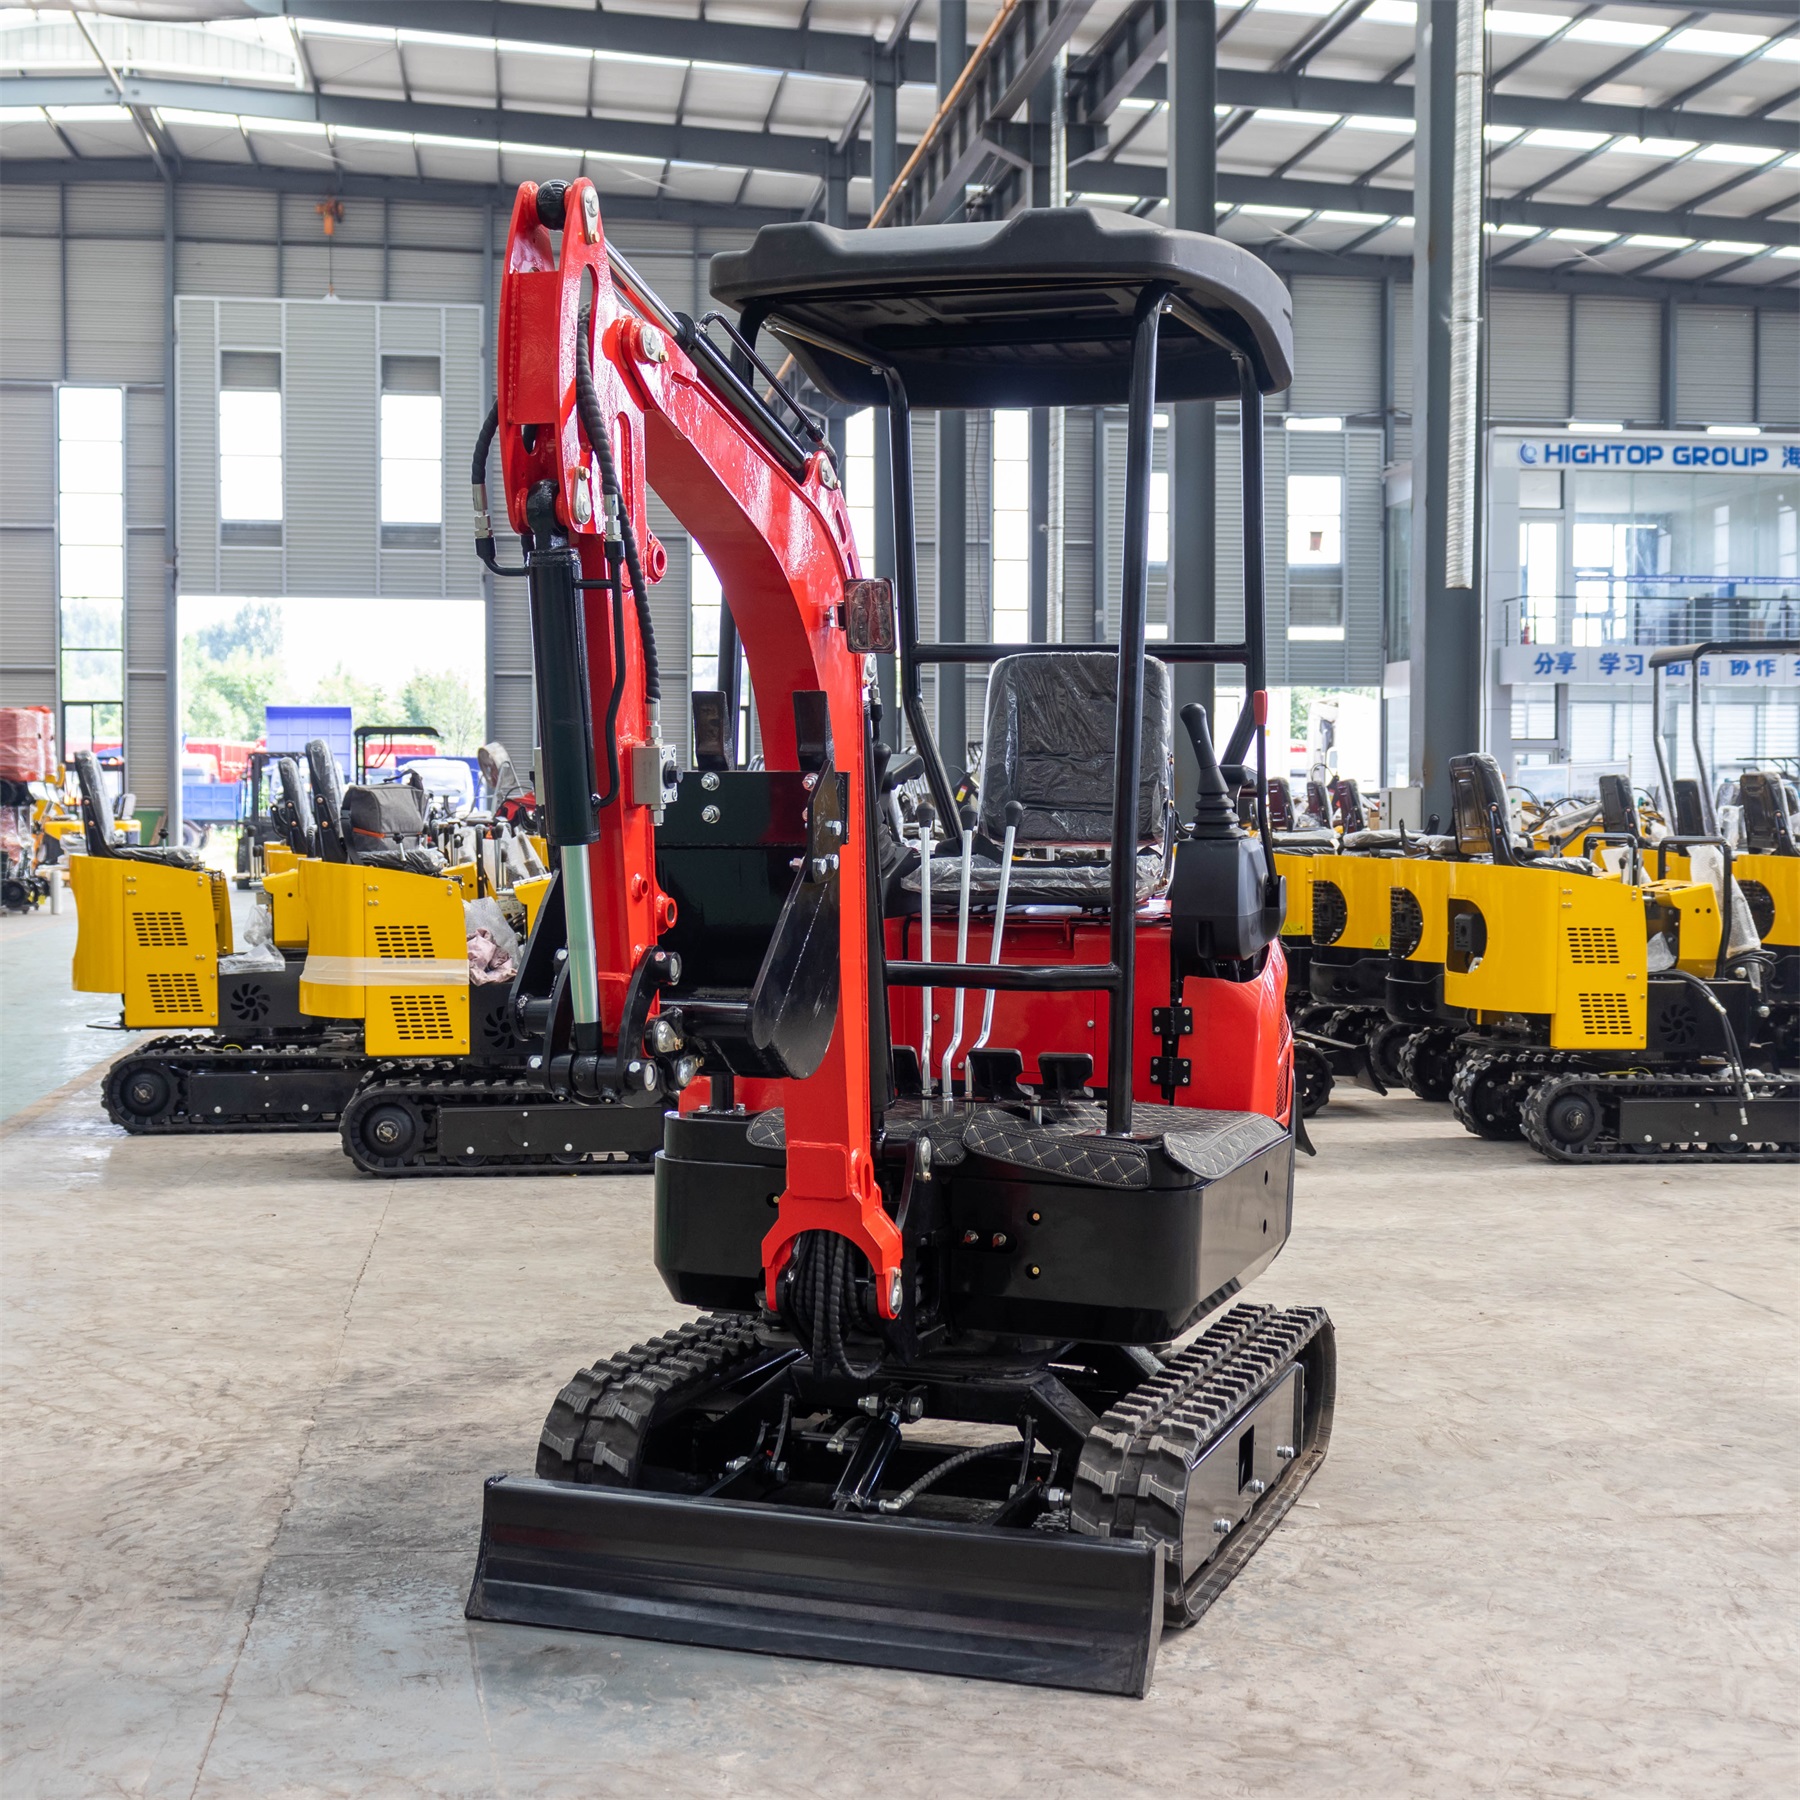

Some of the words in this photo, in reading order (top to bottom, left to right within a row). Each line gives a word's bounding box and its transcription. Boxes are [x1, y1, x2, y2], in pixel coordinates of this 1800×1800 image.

[1544, 444, 1664, 465] HIGHTOP
[1672, 445, 1769, 467] GROUP
[1534, 652, 1576, 675] 分享
[1600, 653, 1645, 676] 学习
[1730, 659, 1776, 677] 协作
